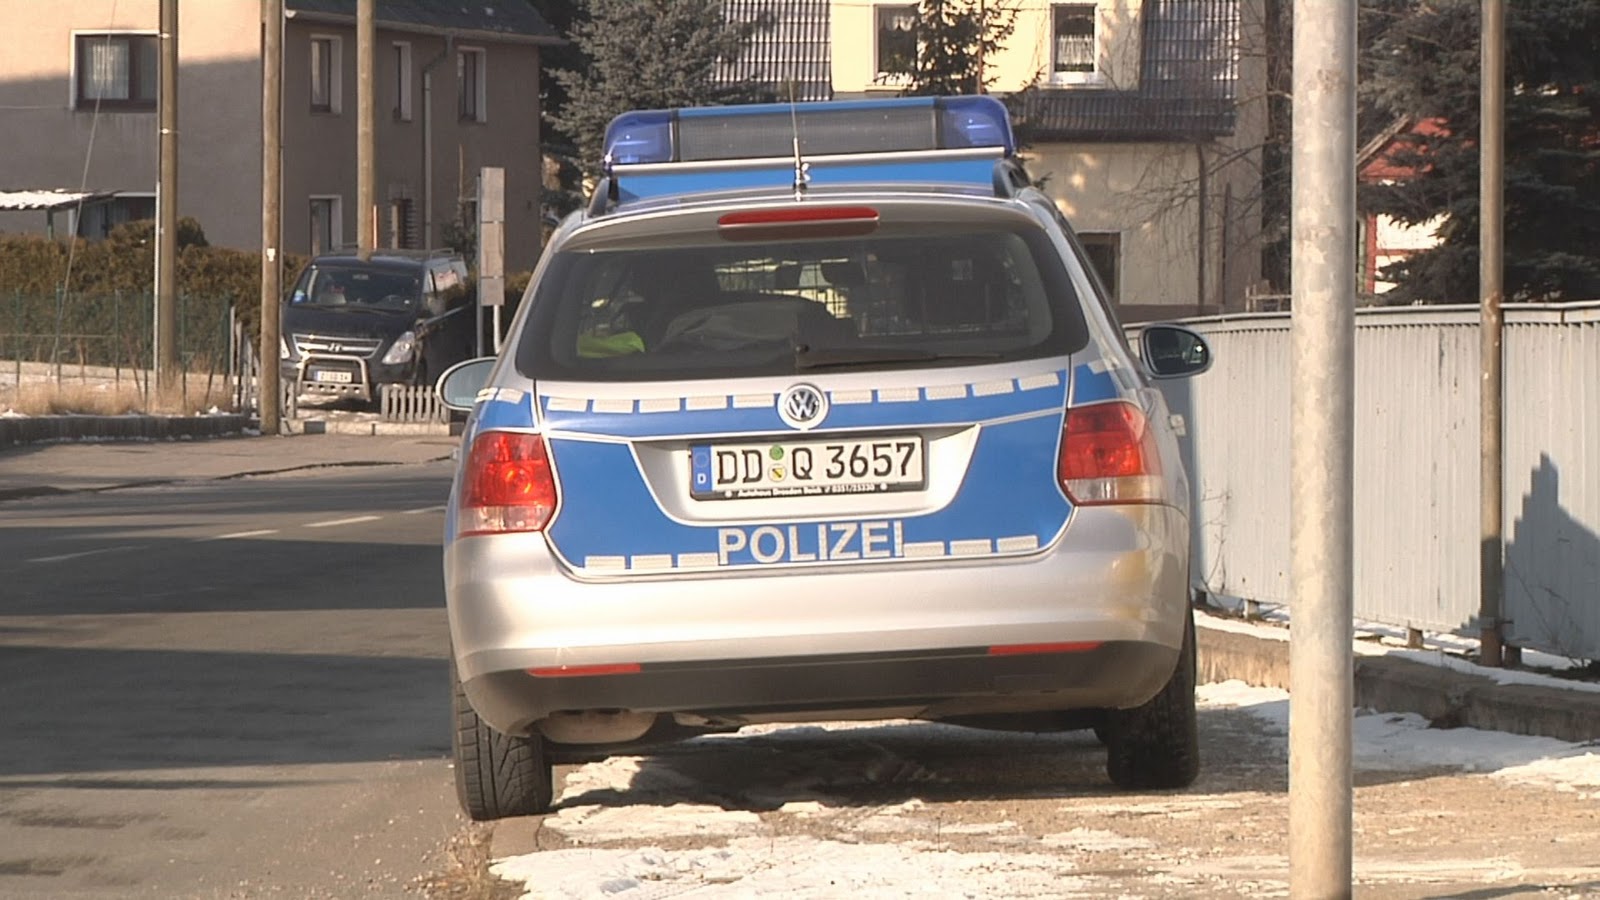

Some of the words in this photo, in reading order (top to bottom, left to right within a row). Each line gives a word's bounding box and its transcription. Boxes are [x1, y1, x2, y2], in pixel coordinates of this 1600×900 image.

[716, 449, 763, 485] DD
[791, 447, 813, 480] Q
[825, 441, 916, 479] 3657
[717, 520, 905, 566] POLIZEI
